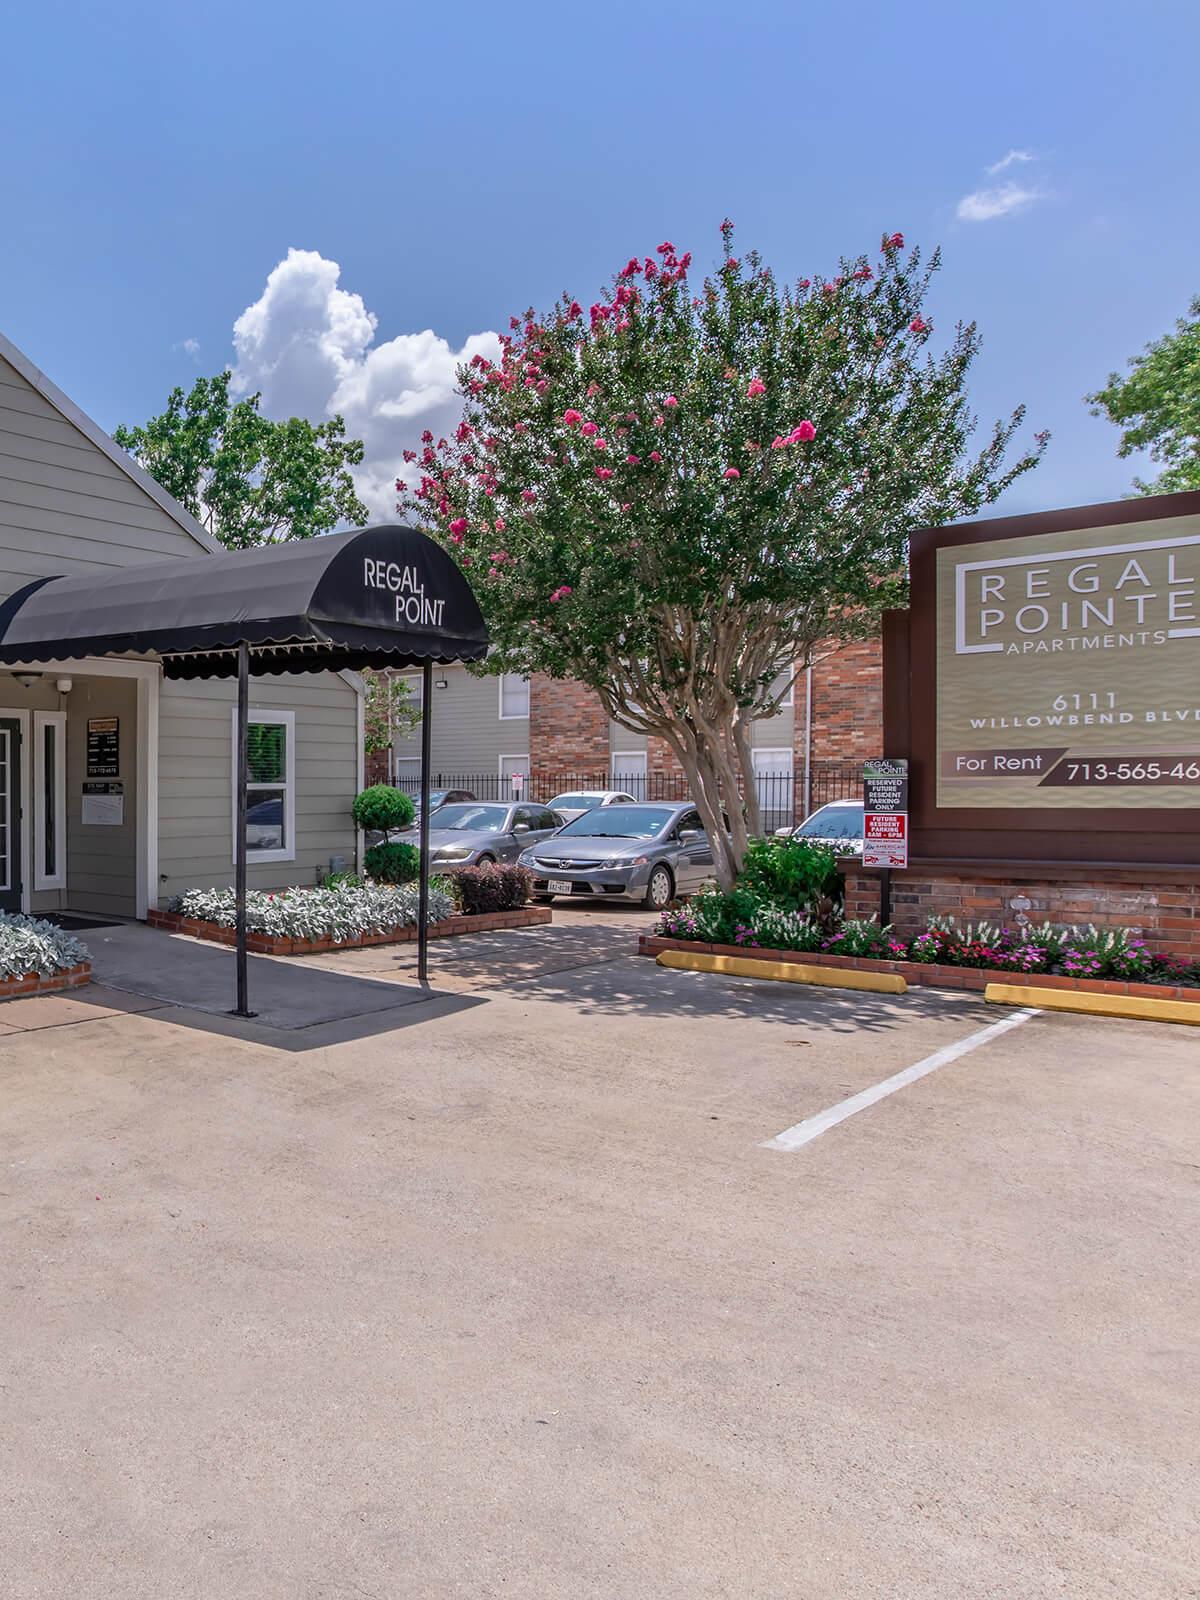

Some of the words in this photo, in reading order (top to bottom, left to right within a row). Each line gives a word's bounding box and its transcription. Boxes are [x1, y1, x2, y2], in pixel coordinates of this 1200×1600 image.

[364, 558, 423, 593] REGAL
[980, 554, 1195, 603] REGAL
[396, 584, 446, 626] POINT
[980, 590, 1197, 637] POINTE
[1006, 630, 1167, 655] APARTMENTS
[1053, 692, 1117, 711] 6111
[970, 712, 1134, 729] WILLOWBEND
[864, 761, 892, 769] REGAL
[956, 757, 987, 771] For
[994, 755, 1043, 770] Rent
[1067, 763, 1200, 780] 713-565-46
